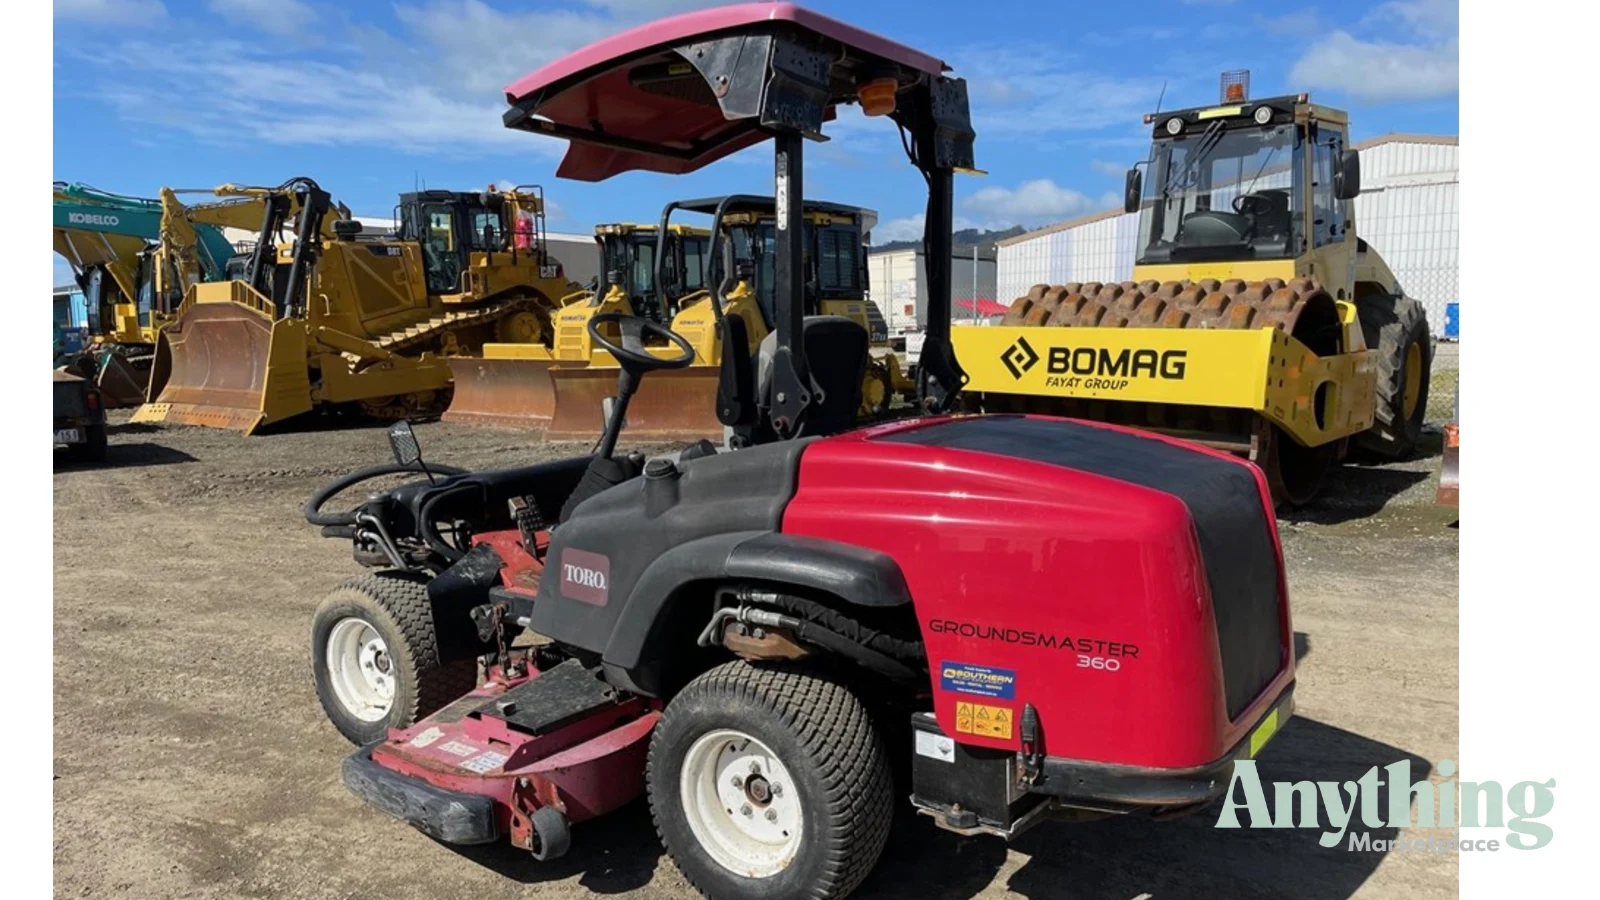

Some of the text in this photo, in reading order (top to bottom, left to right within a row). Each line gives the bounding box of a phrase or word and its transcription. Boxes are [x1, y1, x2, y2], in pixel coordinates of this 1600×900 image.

[69, 212, 119, 226] KOBELCO
[540, 265, 557, 278] CAT
[1047, 347, 1187, 380] BOMAG
[1045, 376, 1128, 391] FAYAT GROUP
[929, 619, 1139, 659] GROUNDSMASTER
[1076, 655, 1121, 671] 360
[955, 669, 1014, 684] SOUTHERN
